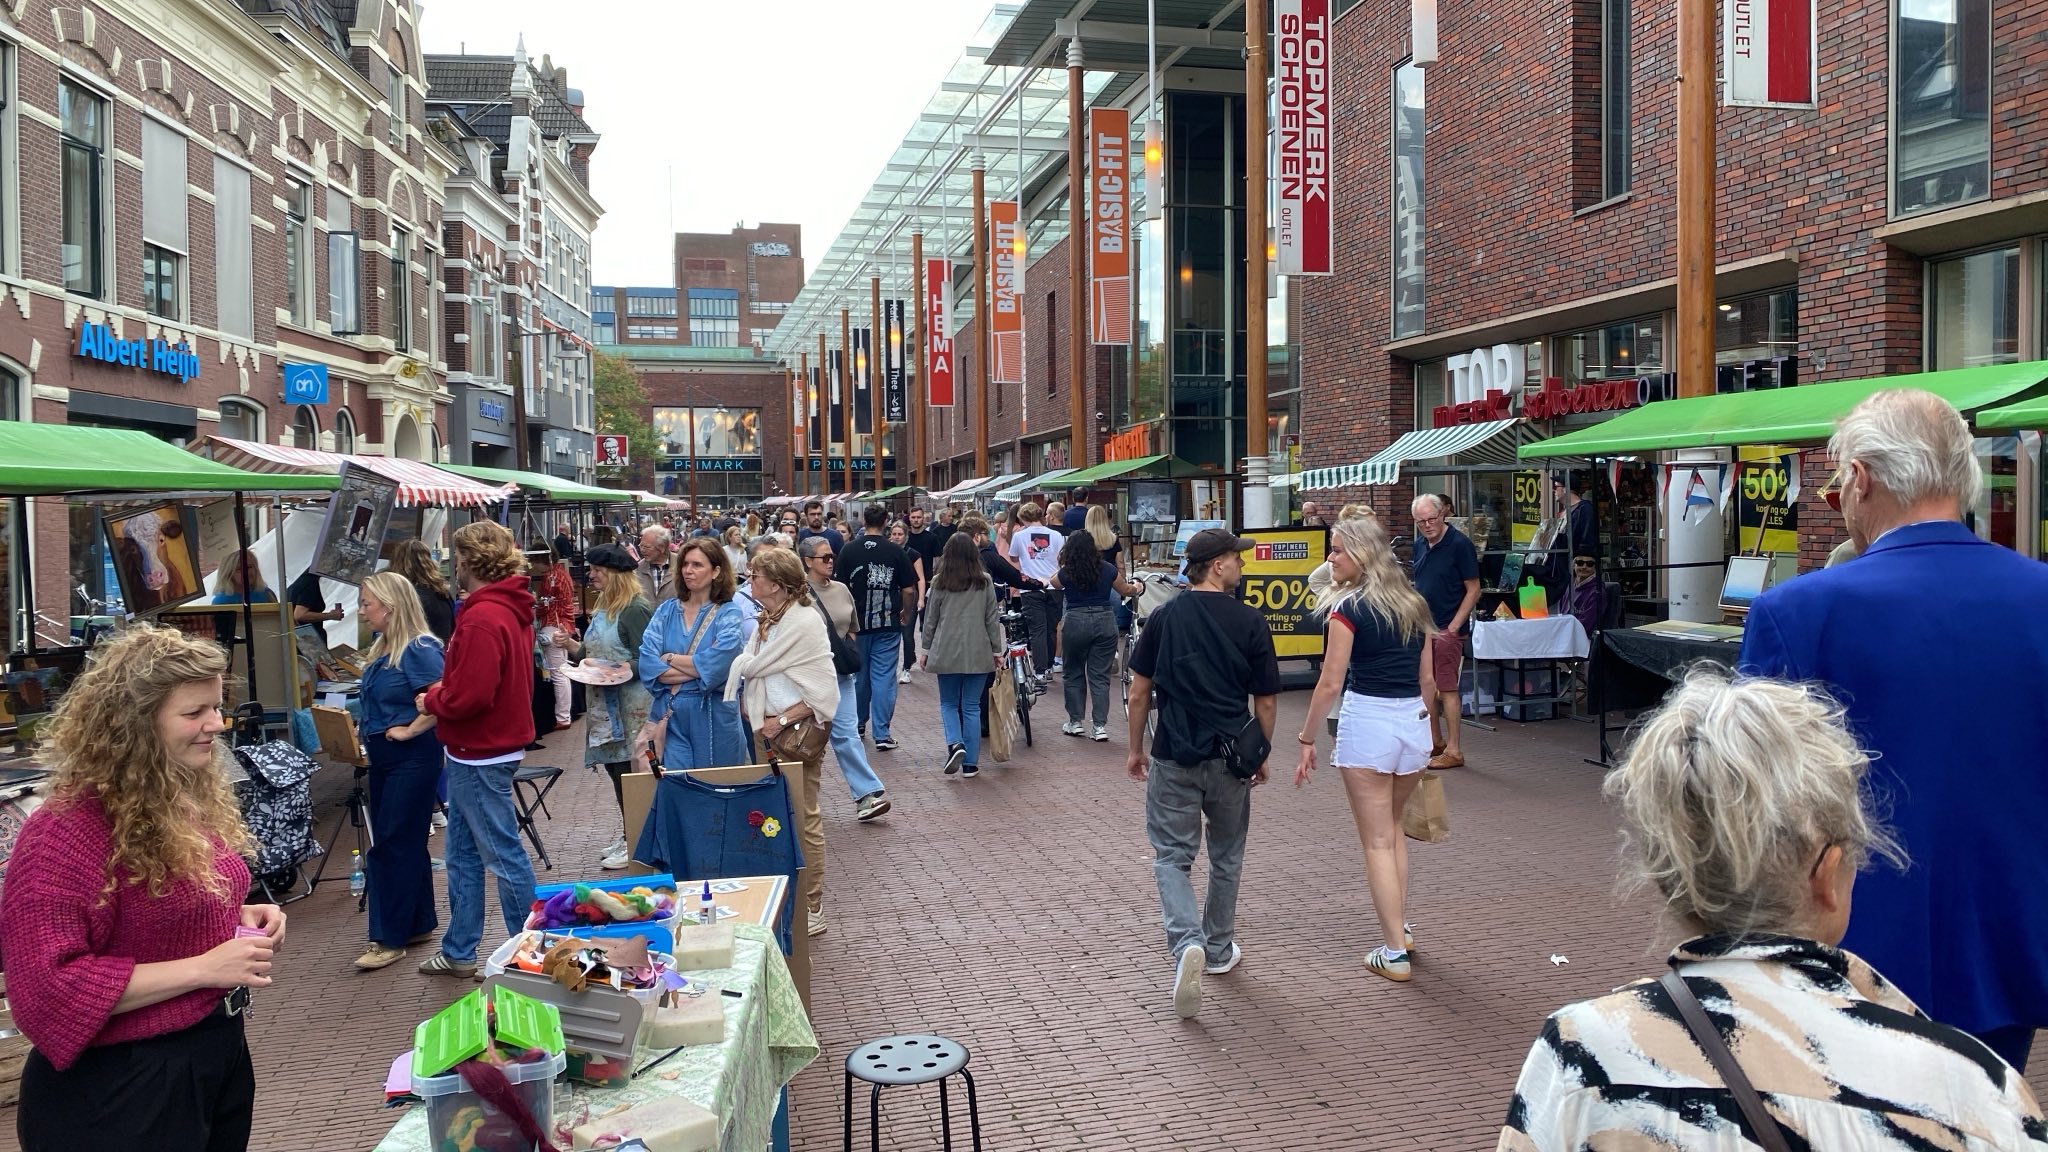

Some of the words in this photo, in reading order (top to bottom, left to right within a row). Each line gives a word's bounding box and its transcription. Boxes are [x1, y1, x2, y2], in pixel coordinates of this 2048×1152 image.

[1736, 0, 1750, 58] UTLET
[1281, 14, 1299, 201] SCHOENEN
[1305, 15, 1326, 203] TOPMERK
[1097, 132, 1123, 253] BASIC-FIT
[1281, 208, 1292, 248] OUTLET
[80, 320, 147, 369] Albert
[153, 338, 200, 384] Heijn
[1447, 343, 1524, 413] TOP
[1637, 355, 1798, 406] OULET
[674, 460, 744, 470] PRIMARK
[1756, 504, 1778, 515] korng
[1767, 517, 1783, 525] LES
[1273, 551, 1307, 559] SCHOENEN
[1274, 543, 1288, 551] TOP
[1243, 580, 1319, 610] 50%
[1263, 613, 1290, 622] orting
[1291, 615, 1302, 623] op
